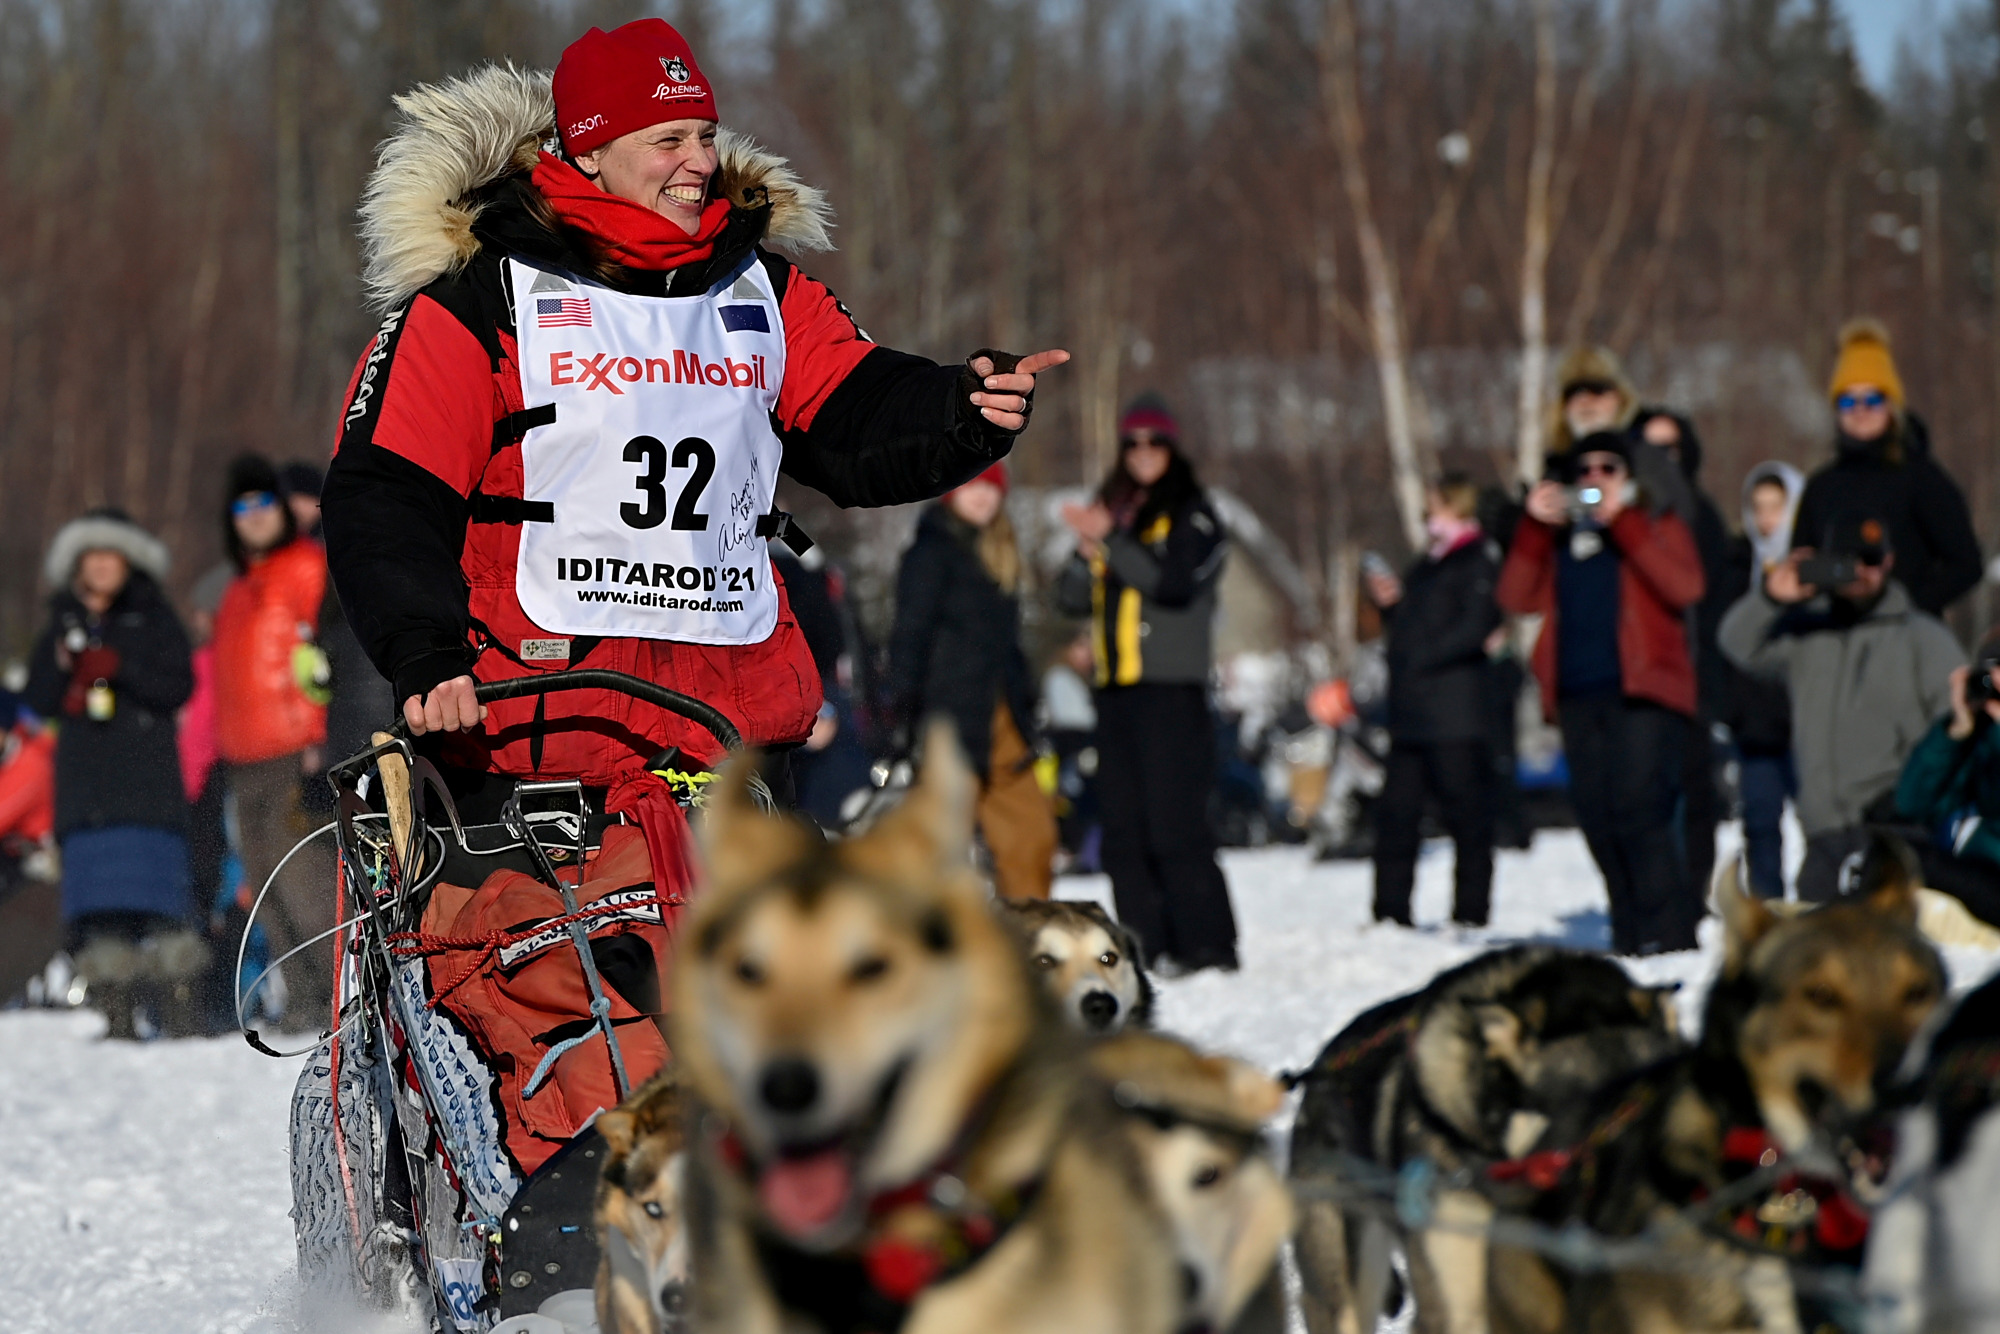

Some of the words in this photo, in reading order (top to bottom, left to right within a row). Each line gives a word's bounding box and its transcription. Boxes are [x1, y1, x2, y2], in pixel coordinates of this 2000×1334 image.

[550, 349, 767, 395] ExxonMobil
[620, 435, 716, 531] 32
[557, 557, 716, 591] IDITAROD
[577, 590, 744, 612] www.iditarod.com
